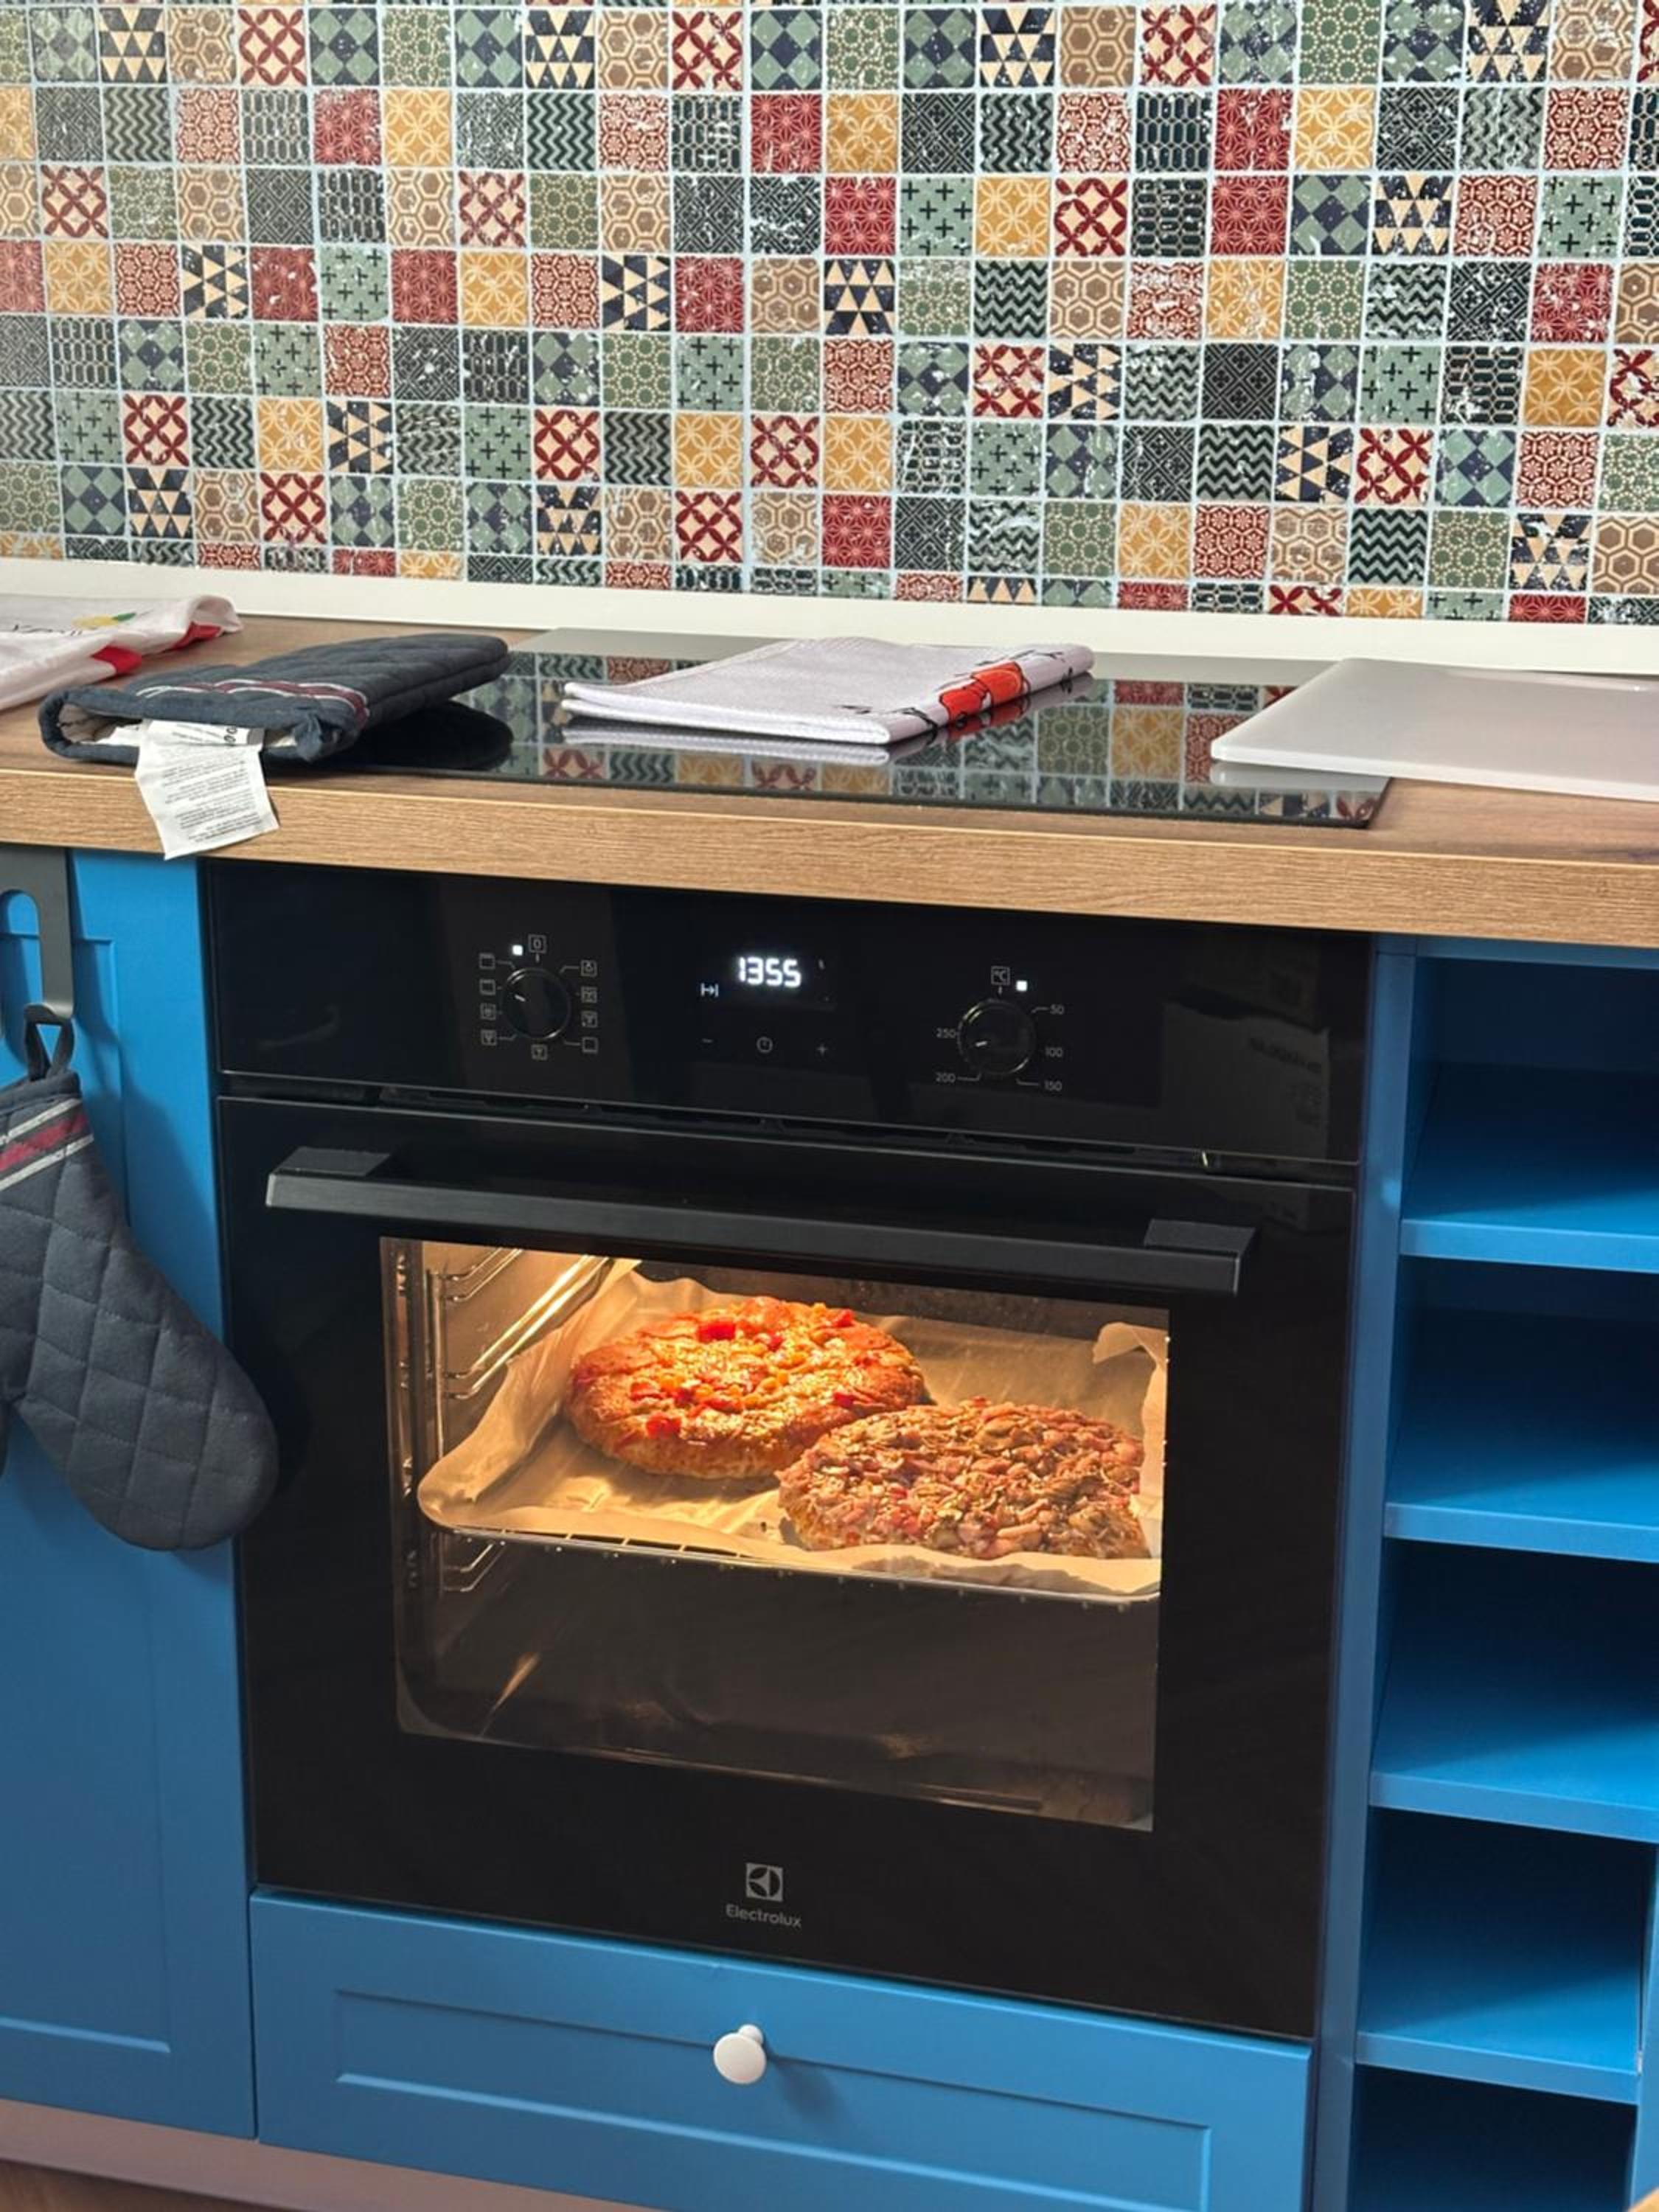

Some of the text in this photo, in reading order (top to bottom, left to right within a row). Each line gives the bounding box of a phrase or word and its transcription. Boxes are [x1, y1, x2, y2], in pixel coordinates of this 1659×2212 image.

[738, 956, 802, 989] 1355
[1050, 1004, 1065, 1015] 50
[936, 1028, 957, 1039] 250
[1045, 1047, 1063, 1057] 100
[936, 1072, 956, 1083] 200
[1044, 1080, 1062, 1091] 150
[726, 1904, 801, 1928] Electrolux
